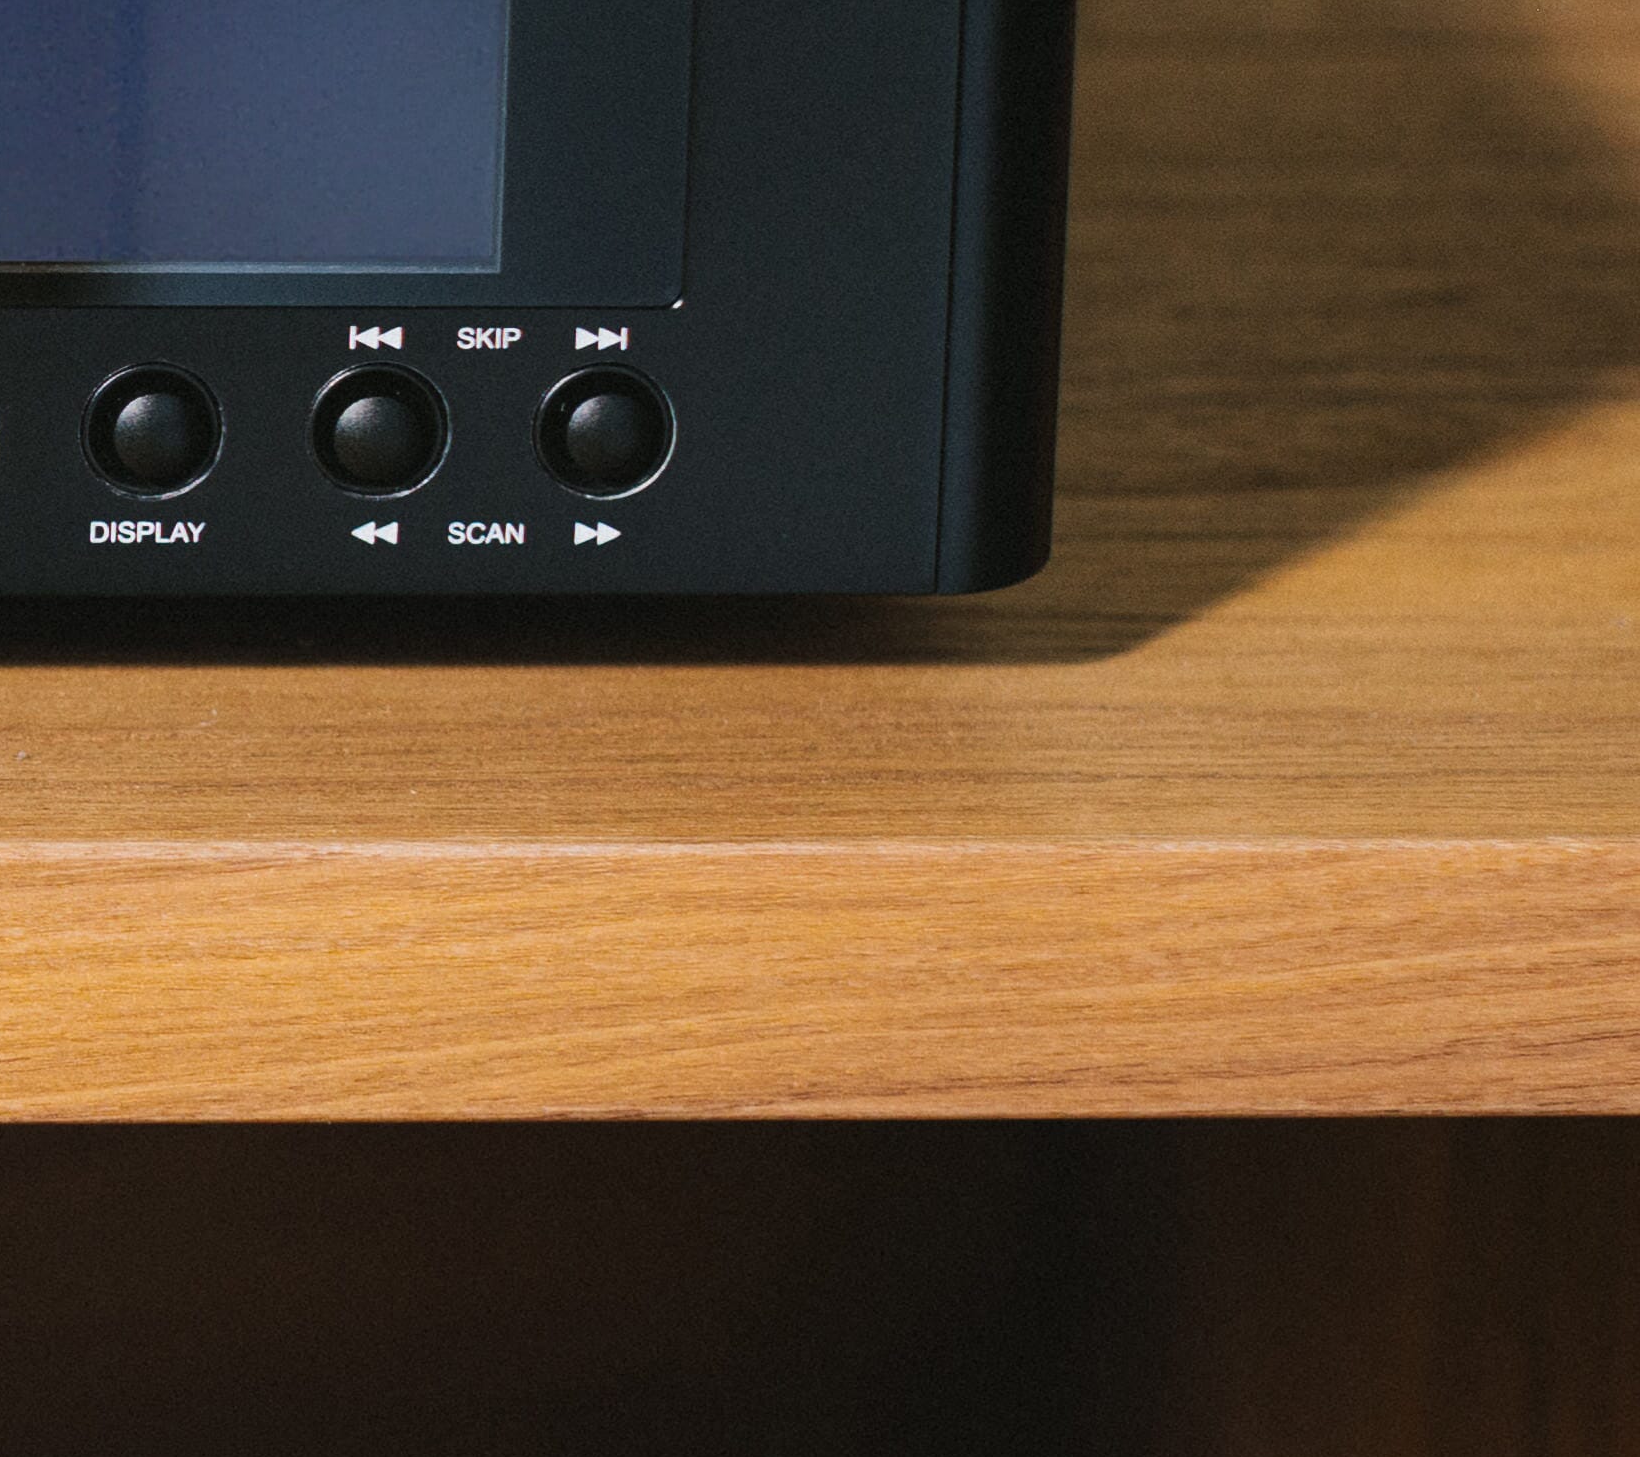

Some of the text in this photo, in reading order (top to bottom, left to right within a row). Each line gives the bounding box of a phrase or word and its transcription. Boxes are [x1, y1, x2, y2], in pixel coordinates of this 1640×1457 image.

[457, 327, 522, 349] SKIP
[90, 521, 205, 543] DISPLAY
[448, 522, 524, 544] SCAN
